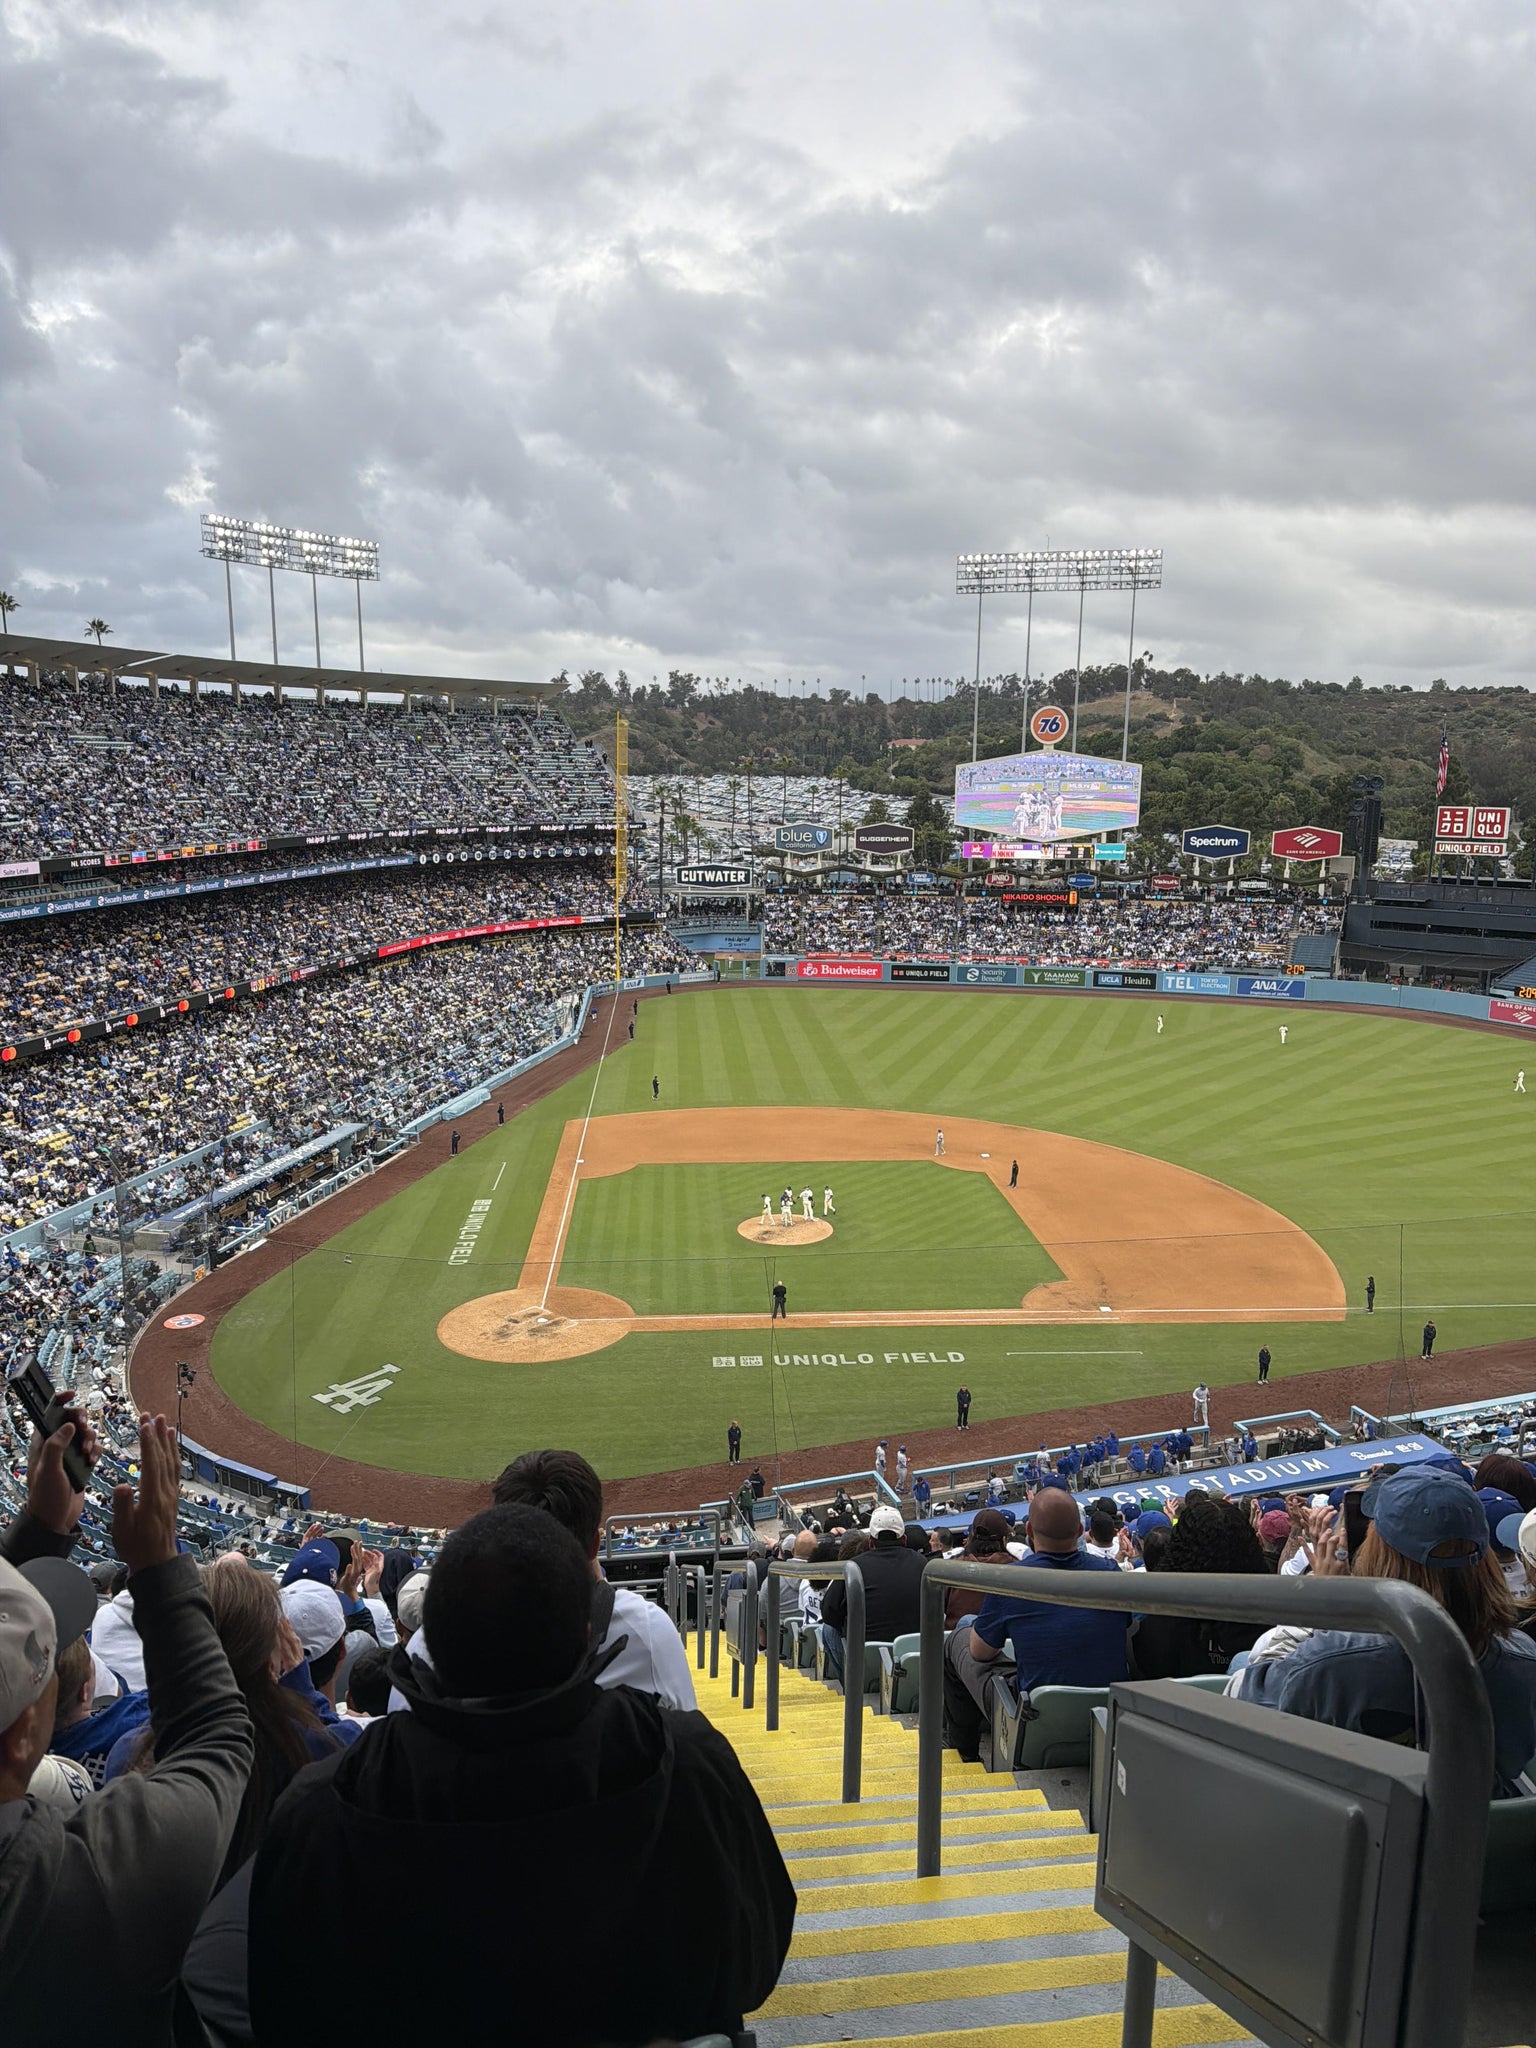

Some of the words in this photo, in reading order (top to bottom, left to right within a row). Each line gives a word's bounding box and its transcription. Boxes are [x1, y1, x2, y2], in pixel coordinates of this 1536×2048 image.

[1038, 716, 1062, 734] 76
[1441, 811, 1464, 822] ユニ
[1478, 812, 1501, 823] UNI
[1440, 823, 1464, 833] クロ
[1477, 824, 1502, 835] QLO
[780, 828, 812, 842] blue
[1189, 836, 1239, 848] Spectrum
[1439, 844, 1471, 853] UNIQLO
[1473, 845, 1500, 853] FIELD
[80, 858, 101, 867] SCORES
[681, 870, 746, 883] CUTWATER
[992, 874, 1009, 882] JINRO
[150, 889, 166, 898] Security
[166, 887, 181, 896] Benefit
[104, 895, 122, 905] Security
[122, 893, 138, 902] Benefit
[21, 906, 41, 916] Benefit
[54, 903, 74, 912] Security
[74, 899, 92, 909] Benefit
[821, 964, 878, 976] Budweiser
[981, 968, 1007, 976] Security
[1286, 964, 1305, 975] 2:09
[1124, 976, 1151, 986] Health
[1165, 976, 1195, 989] TEL
[1251, 980, 1277, 991] ANA
[459, 1213, 487, 1240] UNIQLO
[447, 1241, 476, 1266] FIELD
[773, 1353, 874, 1367] UNIQLO
[883, 1352, 966, 1365] FIELD
[311, 1363, 403, 1414] LA
[1188, 1457, 1330, 1492] STADIUM
